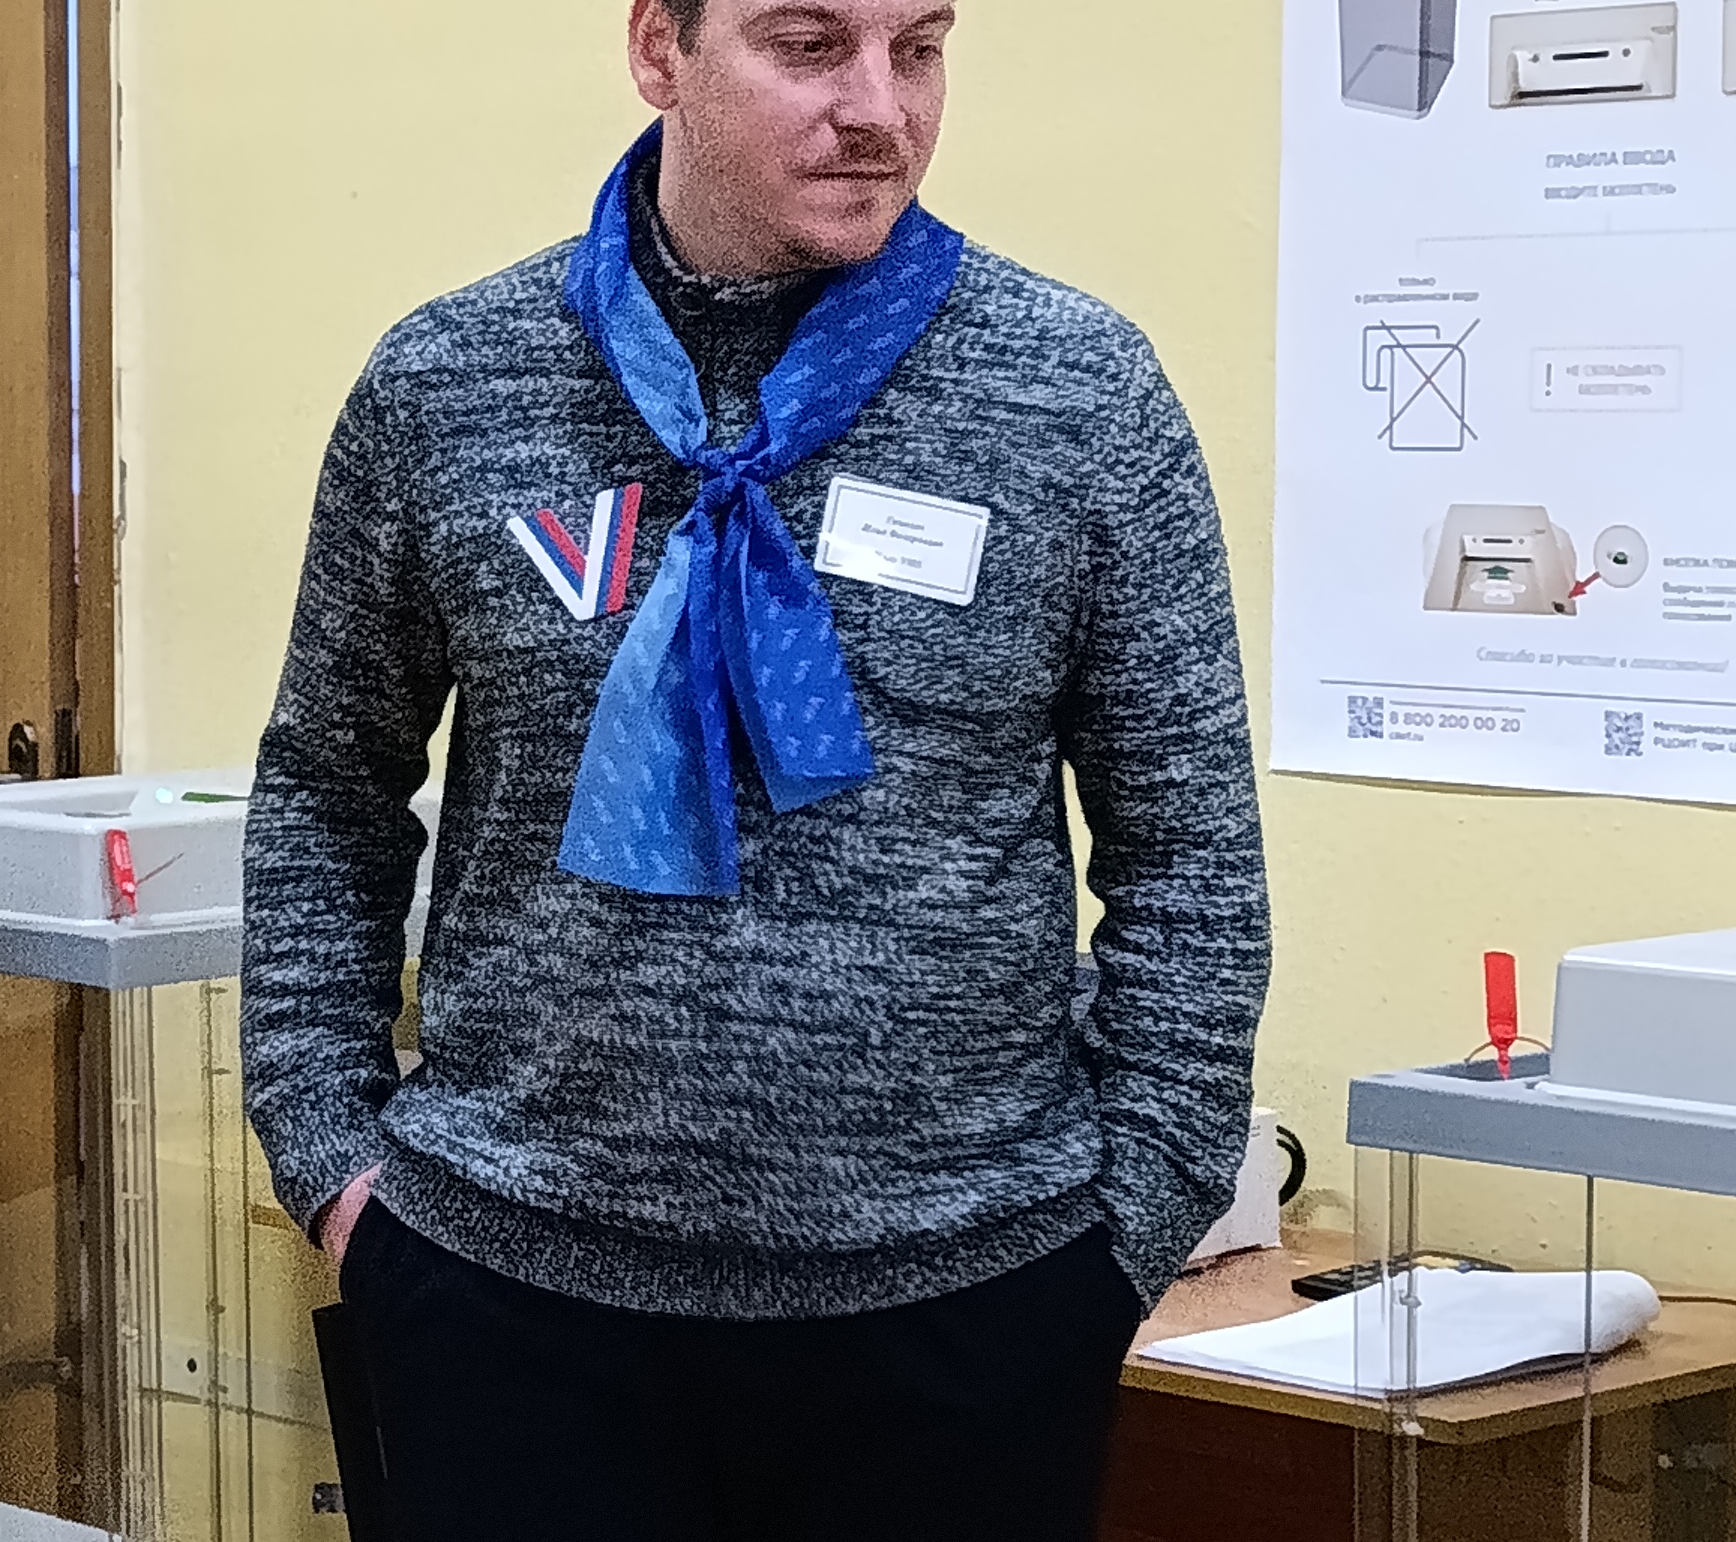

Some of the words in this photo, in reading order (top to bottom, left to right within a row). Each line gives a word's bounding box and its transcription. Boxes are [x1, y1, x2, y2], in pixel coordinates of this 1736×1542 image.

[1389, 710, 1399, 725] 8
[1402, 712, 1435, 727] 800
[1438, 713, 1470, 729] 200
[1473, 716, 1496, 731] 00
[1500, 718, 1521, 733] 20
